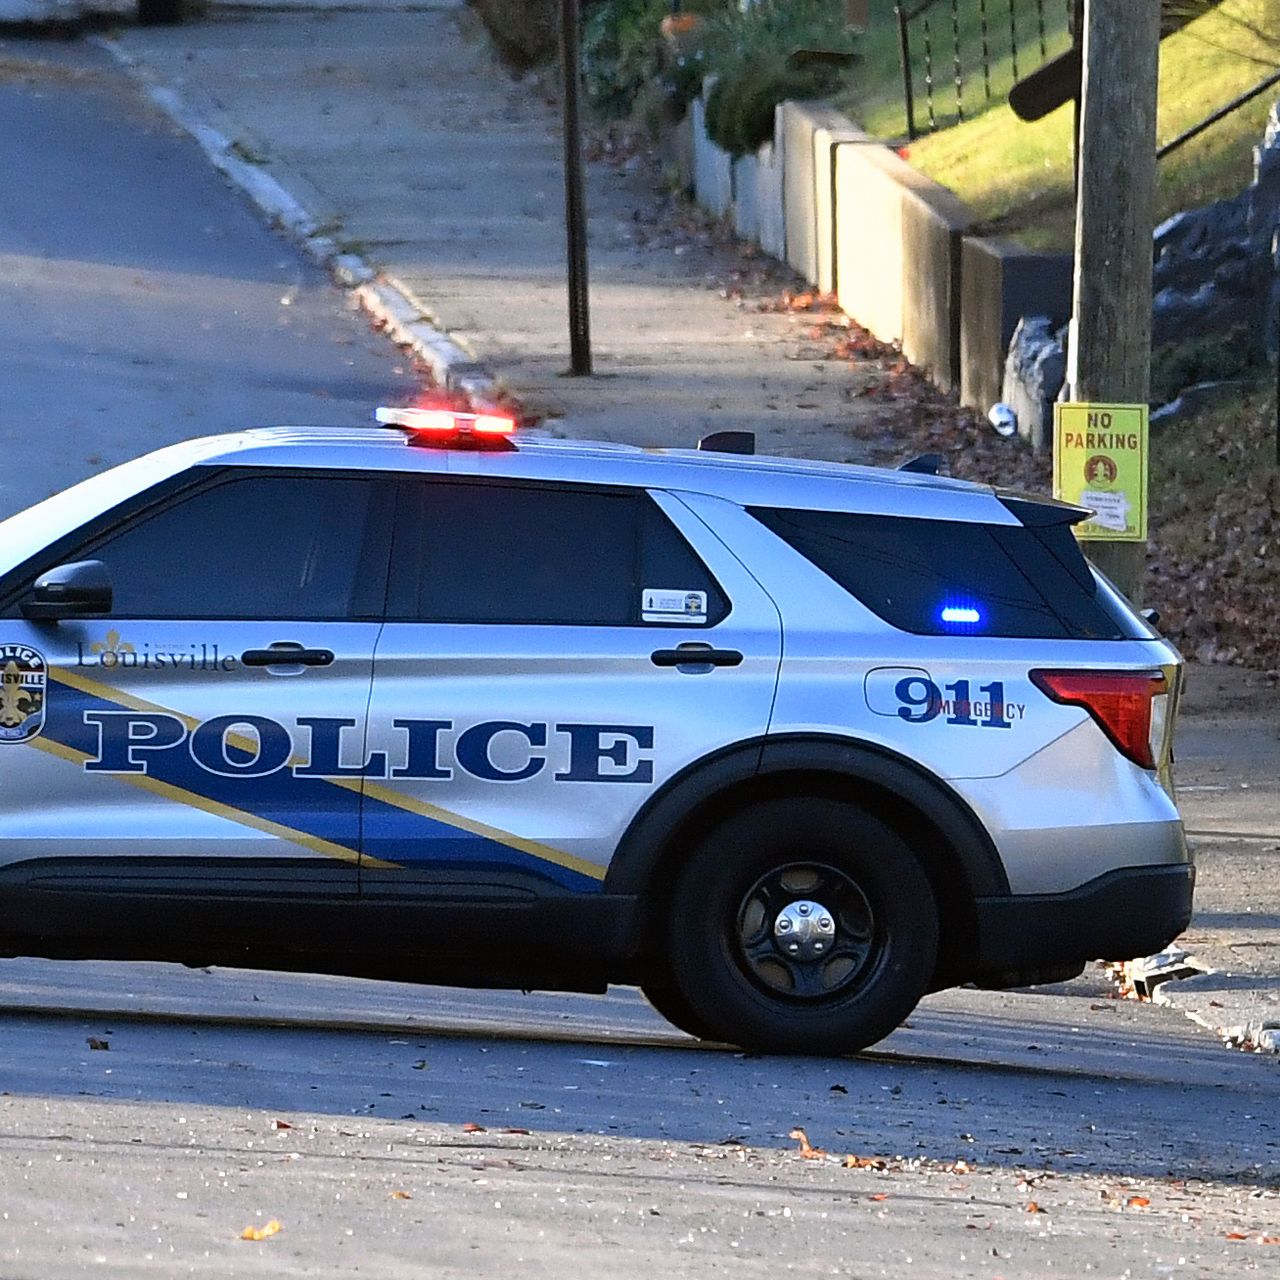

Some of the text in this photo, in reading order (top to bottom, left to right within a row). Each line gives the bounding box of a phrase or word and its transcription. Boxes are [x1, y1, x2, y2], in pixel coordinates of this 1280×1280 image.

[1087, 412, 1112, 429] NO
[1064, 432, 1138, 450] PARKING
[74, 640, 237, 672] Louisville
[894, 676, 1012, 729] 911
[927, 699, 1026, 720] MGECY
[83, 710, 655, 784] POLICE
